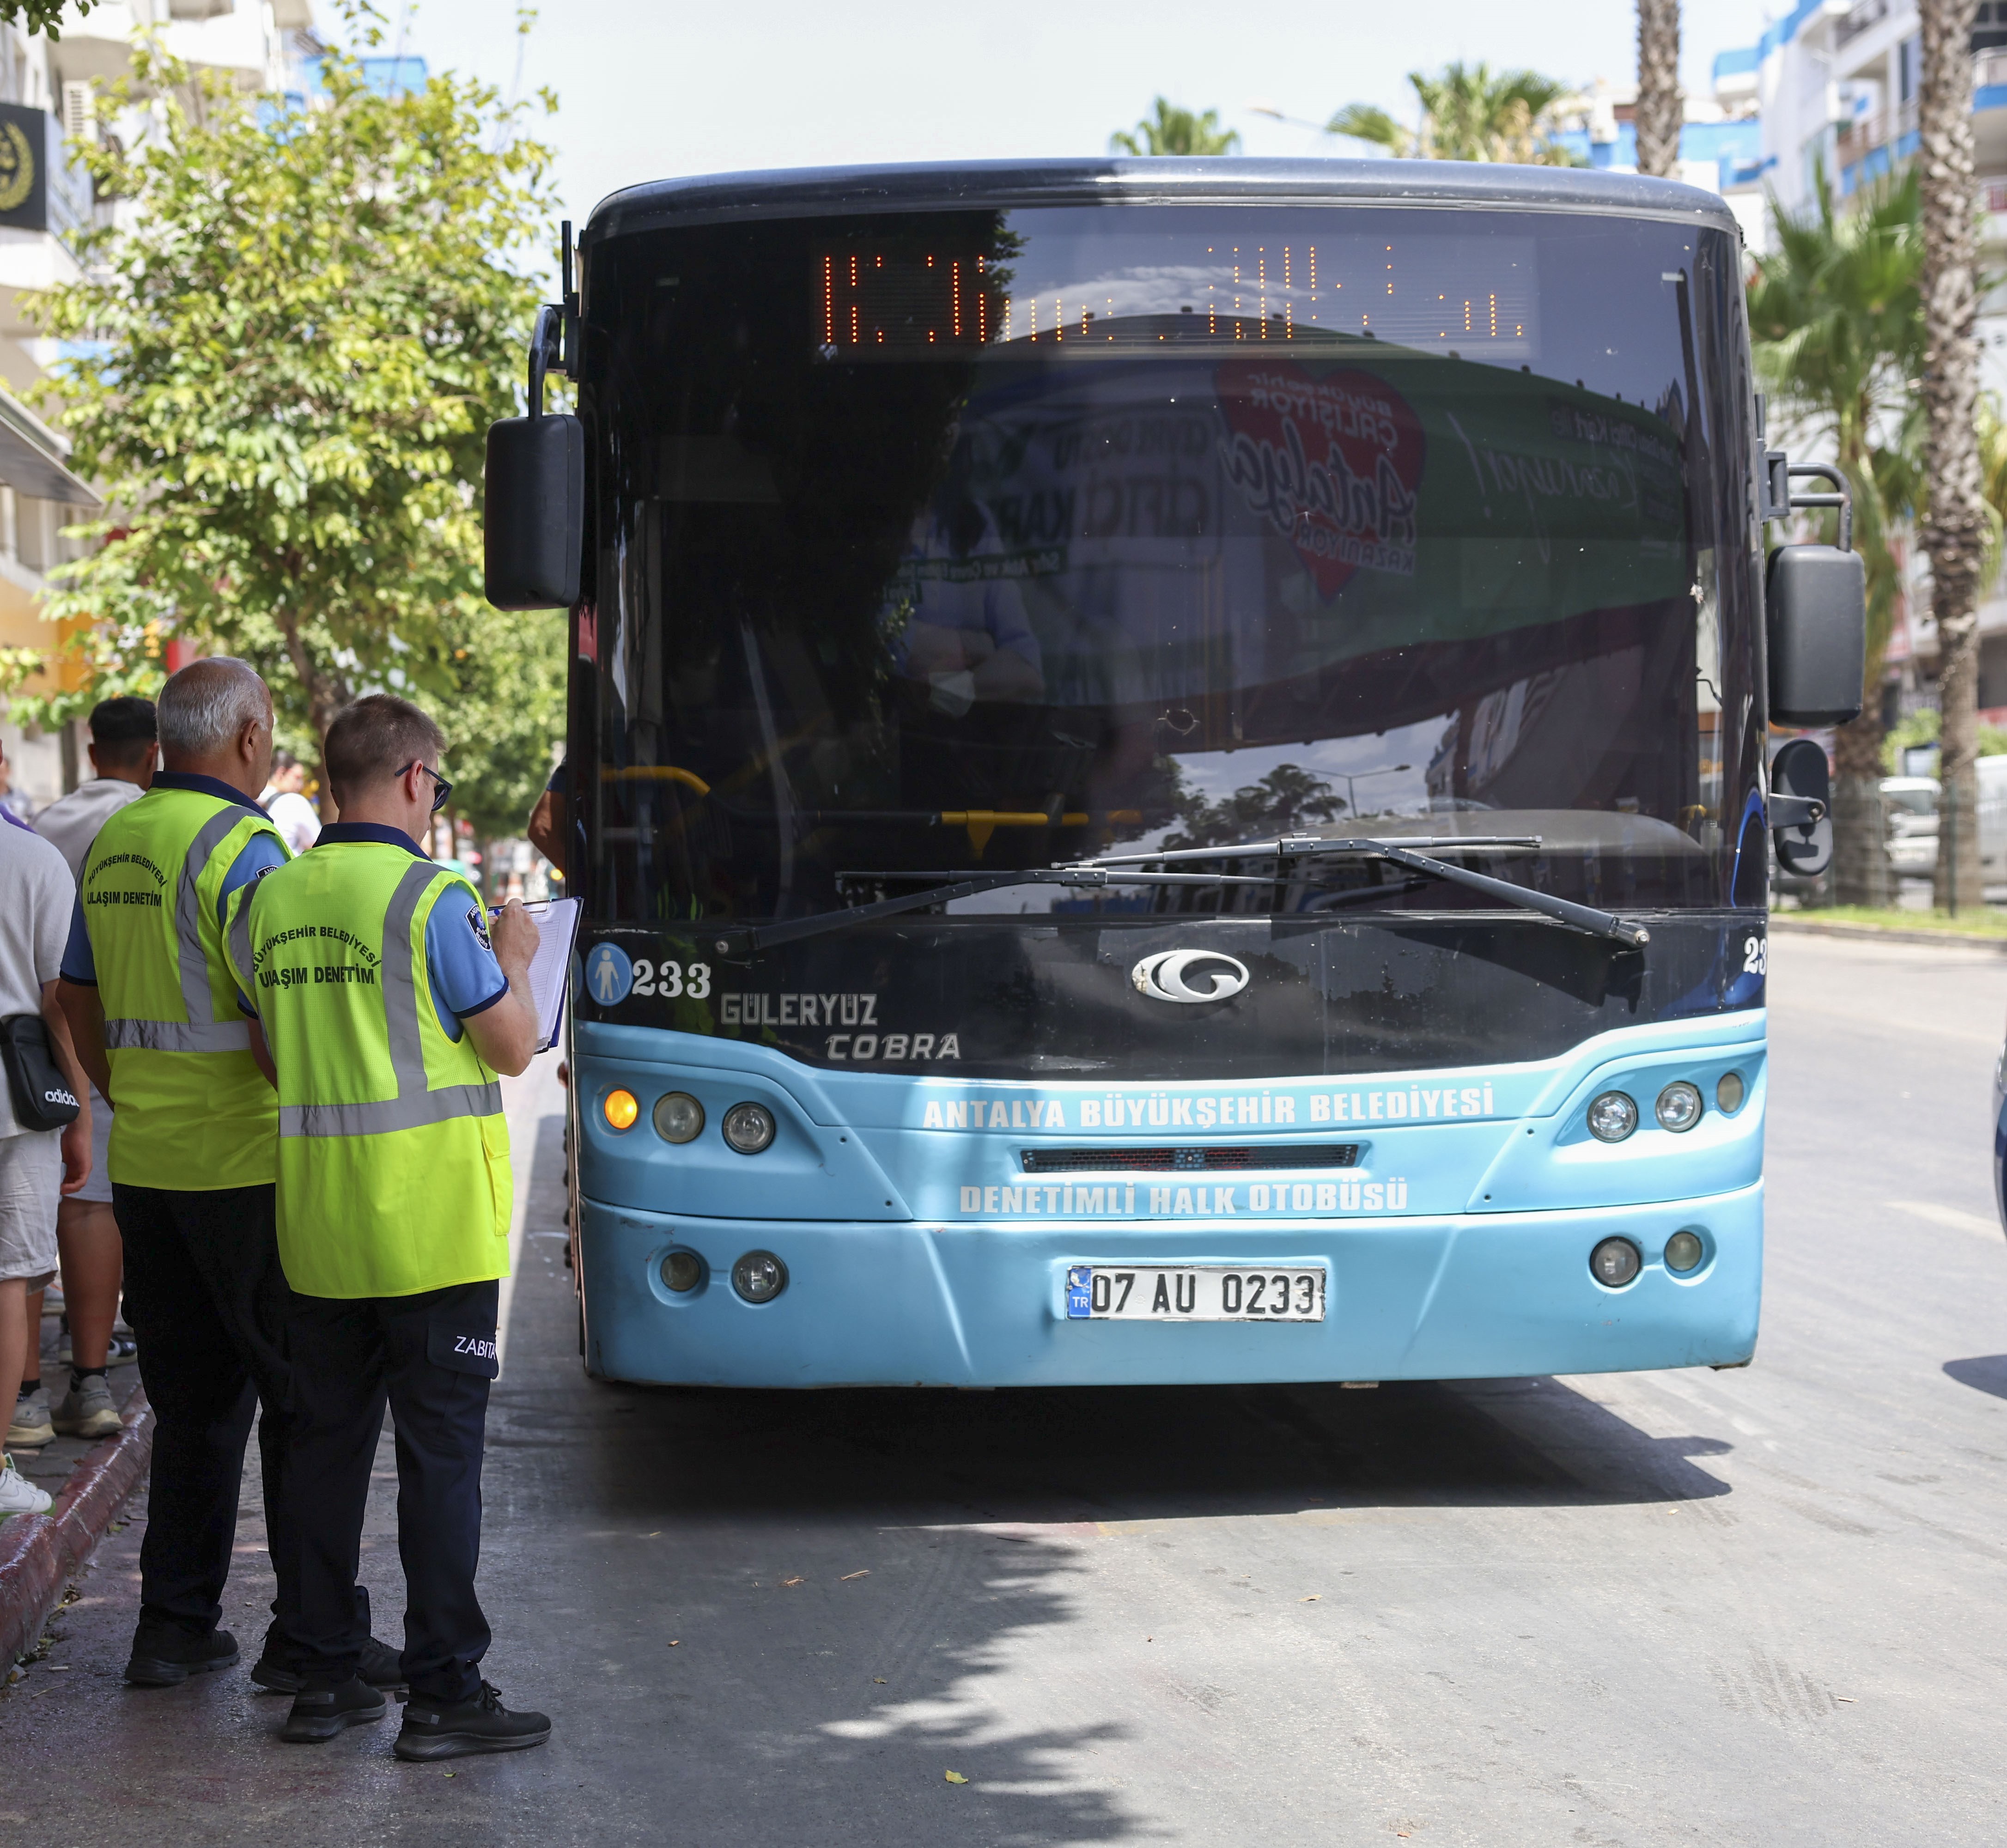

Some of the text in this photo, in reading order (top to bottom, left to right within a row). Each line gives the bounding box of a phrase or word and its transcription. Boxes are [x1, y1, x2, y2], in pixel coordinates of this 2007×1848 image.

[88, 852, 167, 888] BÜYÜKŞEHİR BELEDİYESİ
[87, 890, 162, 907] ULAŞIM DENETİM
[253, 924, 382, 973] BÜYÜKŞEHİR BELEDİYESİ
[314, 963, 375, 985] DENETİM
[632, 959, 711, 999] 233
[721, 992, 878, 1026] GÜLERYÜZ
[825, 1033, 961, 1060] COBRA
[923, 1082, 1494, 1129] ANTALYA BÜYÜKŞEHİR BELEDİYESİ
[960, 1177, 1408, 1215] DENETİMLİ HALK OTOBÜSÜ
[1072, 1296, 1089, 1308] TR
[1091, 1273, 1315, 1314] 07 AU 0233
